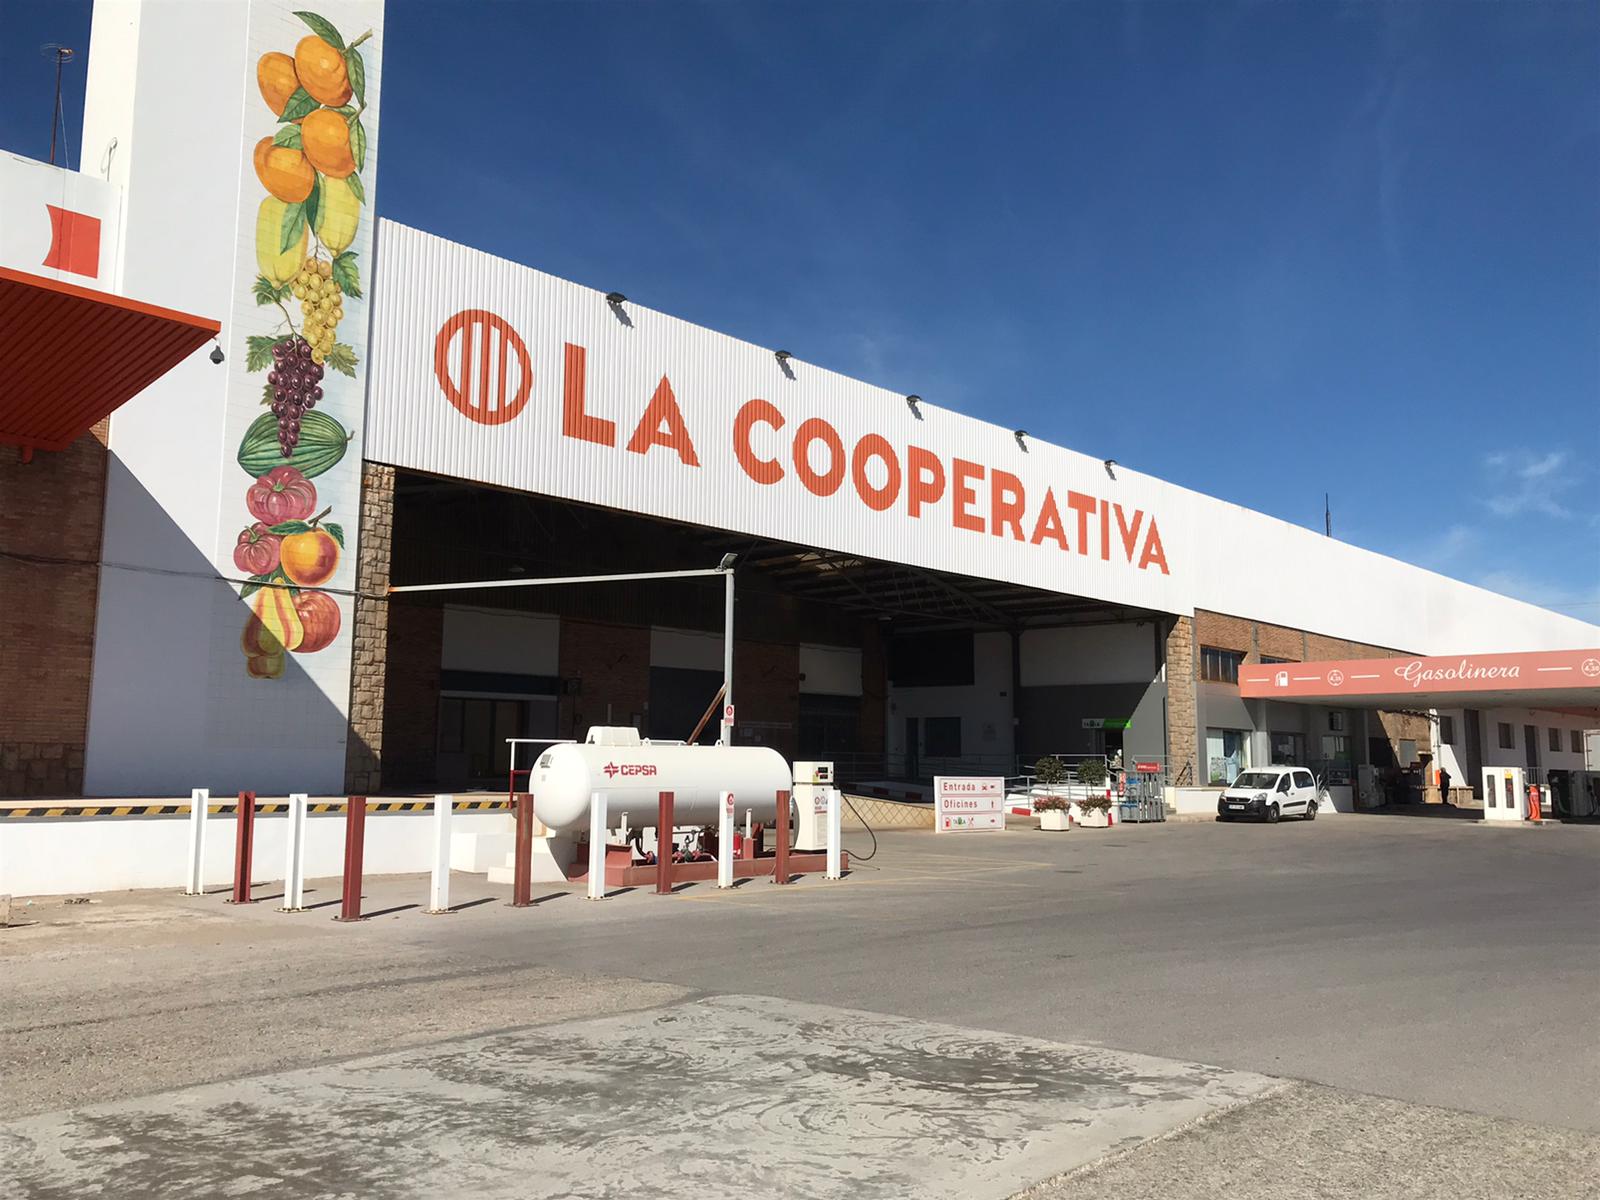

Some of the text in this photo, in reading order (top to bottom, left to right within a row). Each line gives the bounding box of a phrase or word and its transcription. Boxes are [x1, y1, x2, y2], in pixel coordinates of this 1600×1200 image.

[562, 342, 1169, 575] LA COOPERATIVA
[1394, 659, 1520, 688] Gasolinera
[621, 764, 657, 776] CEPSA
[943, 782, 976, 791] Entrada
[944, 799, 978, 809] Oficines
